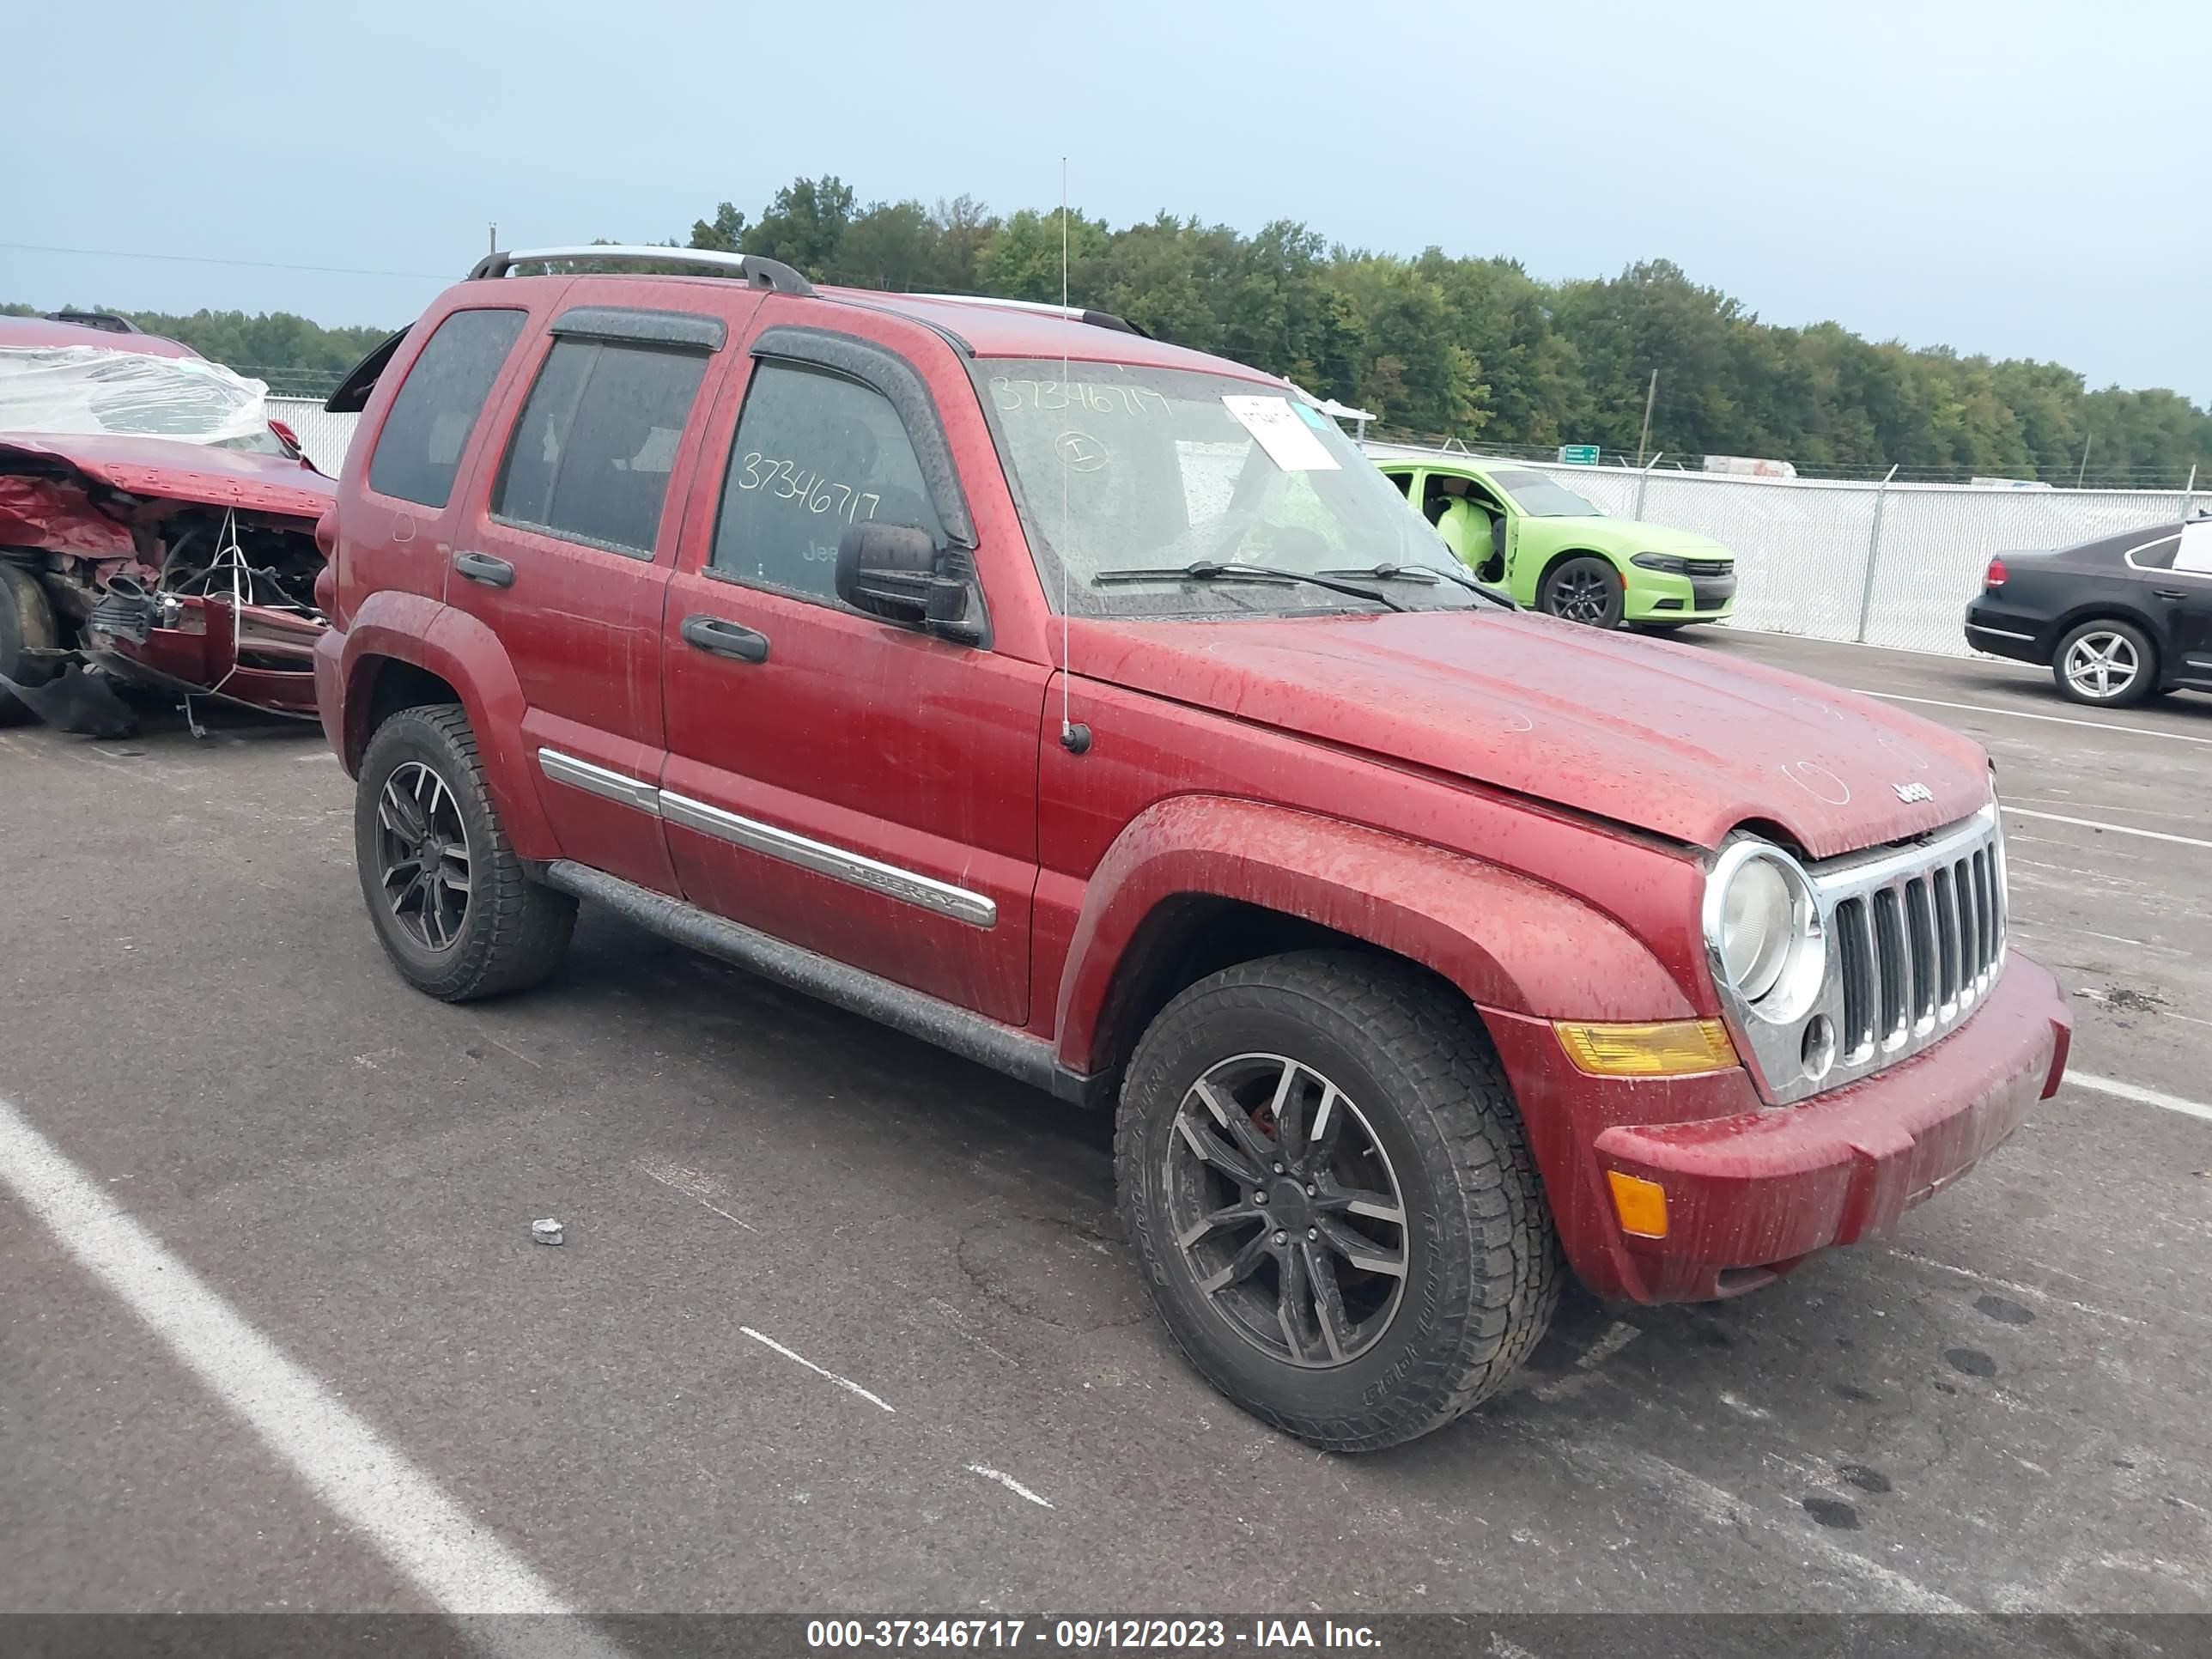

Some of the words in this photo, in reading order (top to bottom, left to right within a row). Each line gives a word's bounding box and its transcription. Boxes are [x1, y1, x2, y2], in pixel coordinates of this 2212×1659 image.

[988, 376, 1174, 419] 37346717
[738, 452, 881, 526] 37346717
[802, 539, 838, 562] Jee
[1890, 782, 1935, 805] Jeep
[848, 866, 957, 909] LIBERTY
